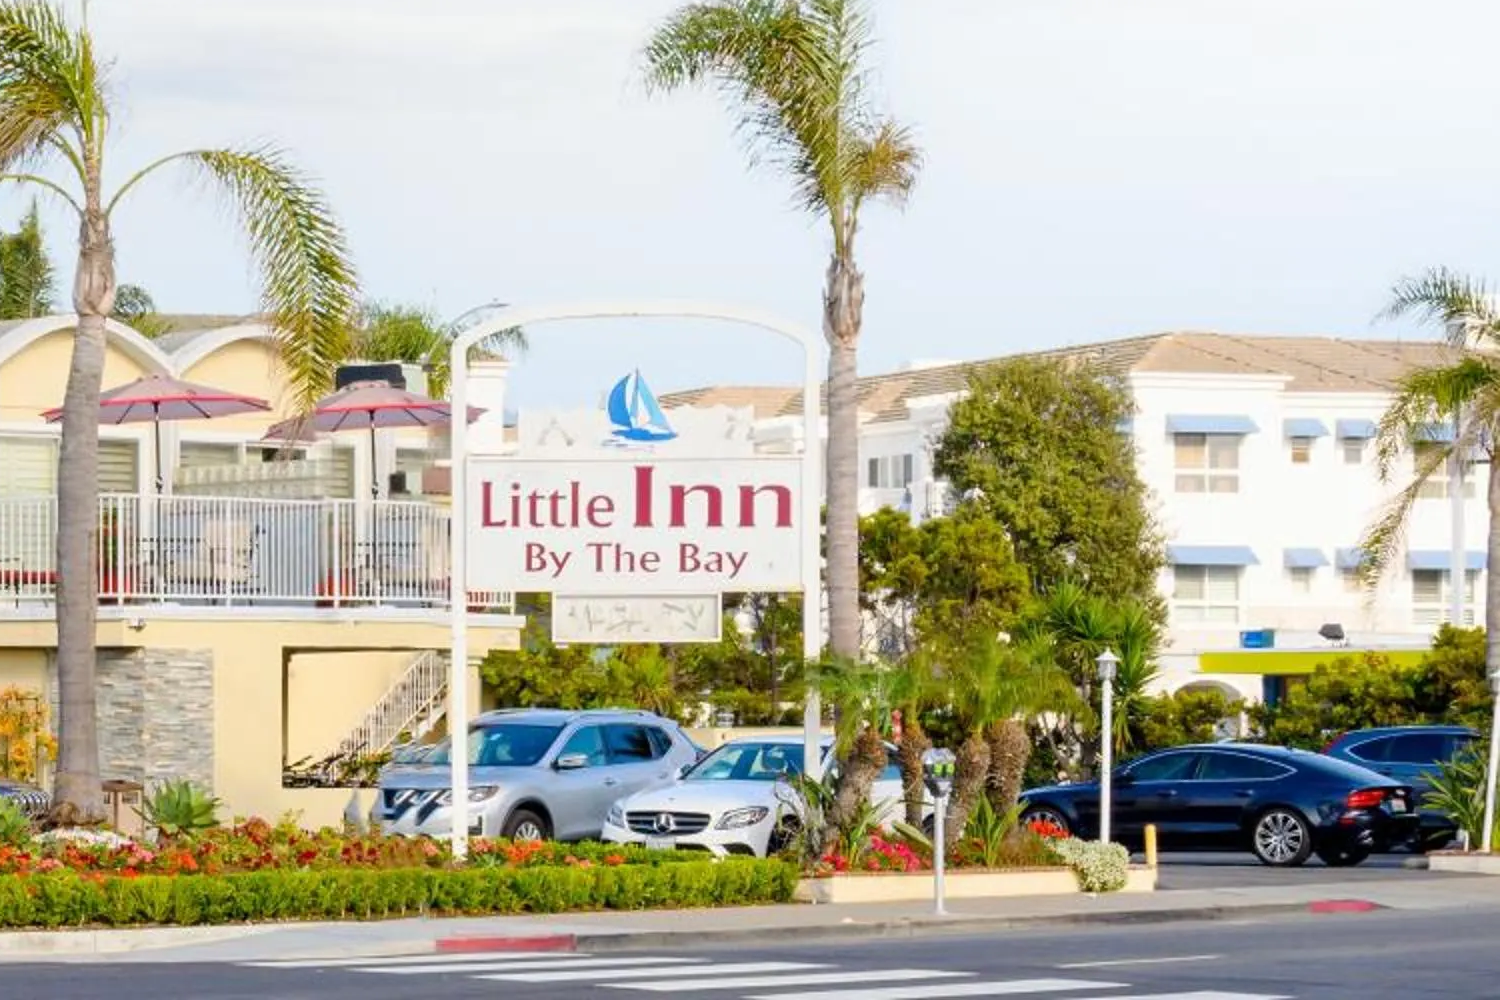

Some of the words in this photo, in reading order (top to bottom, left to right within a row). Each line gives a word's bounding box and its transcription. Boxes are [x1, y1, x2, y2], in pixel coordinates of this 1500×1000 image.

[481, 481, 615, 529] Little
[633, 465, 793, 528] Inn
[525, 543, 572, 579] By
[587, 543, 661, 573] The
[679, 543, 748, 579] Bay
